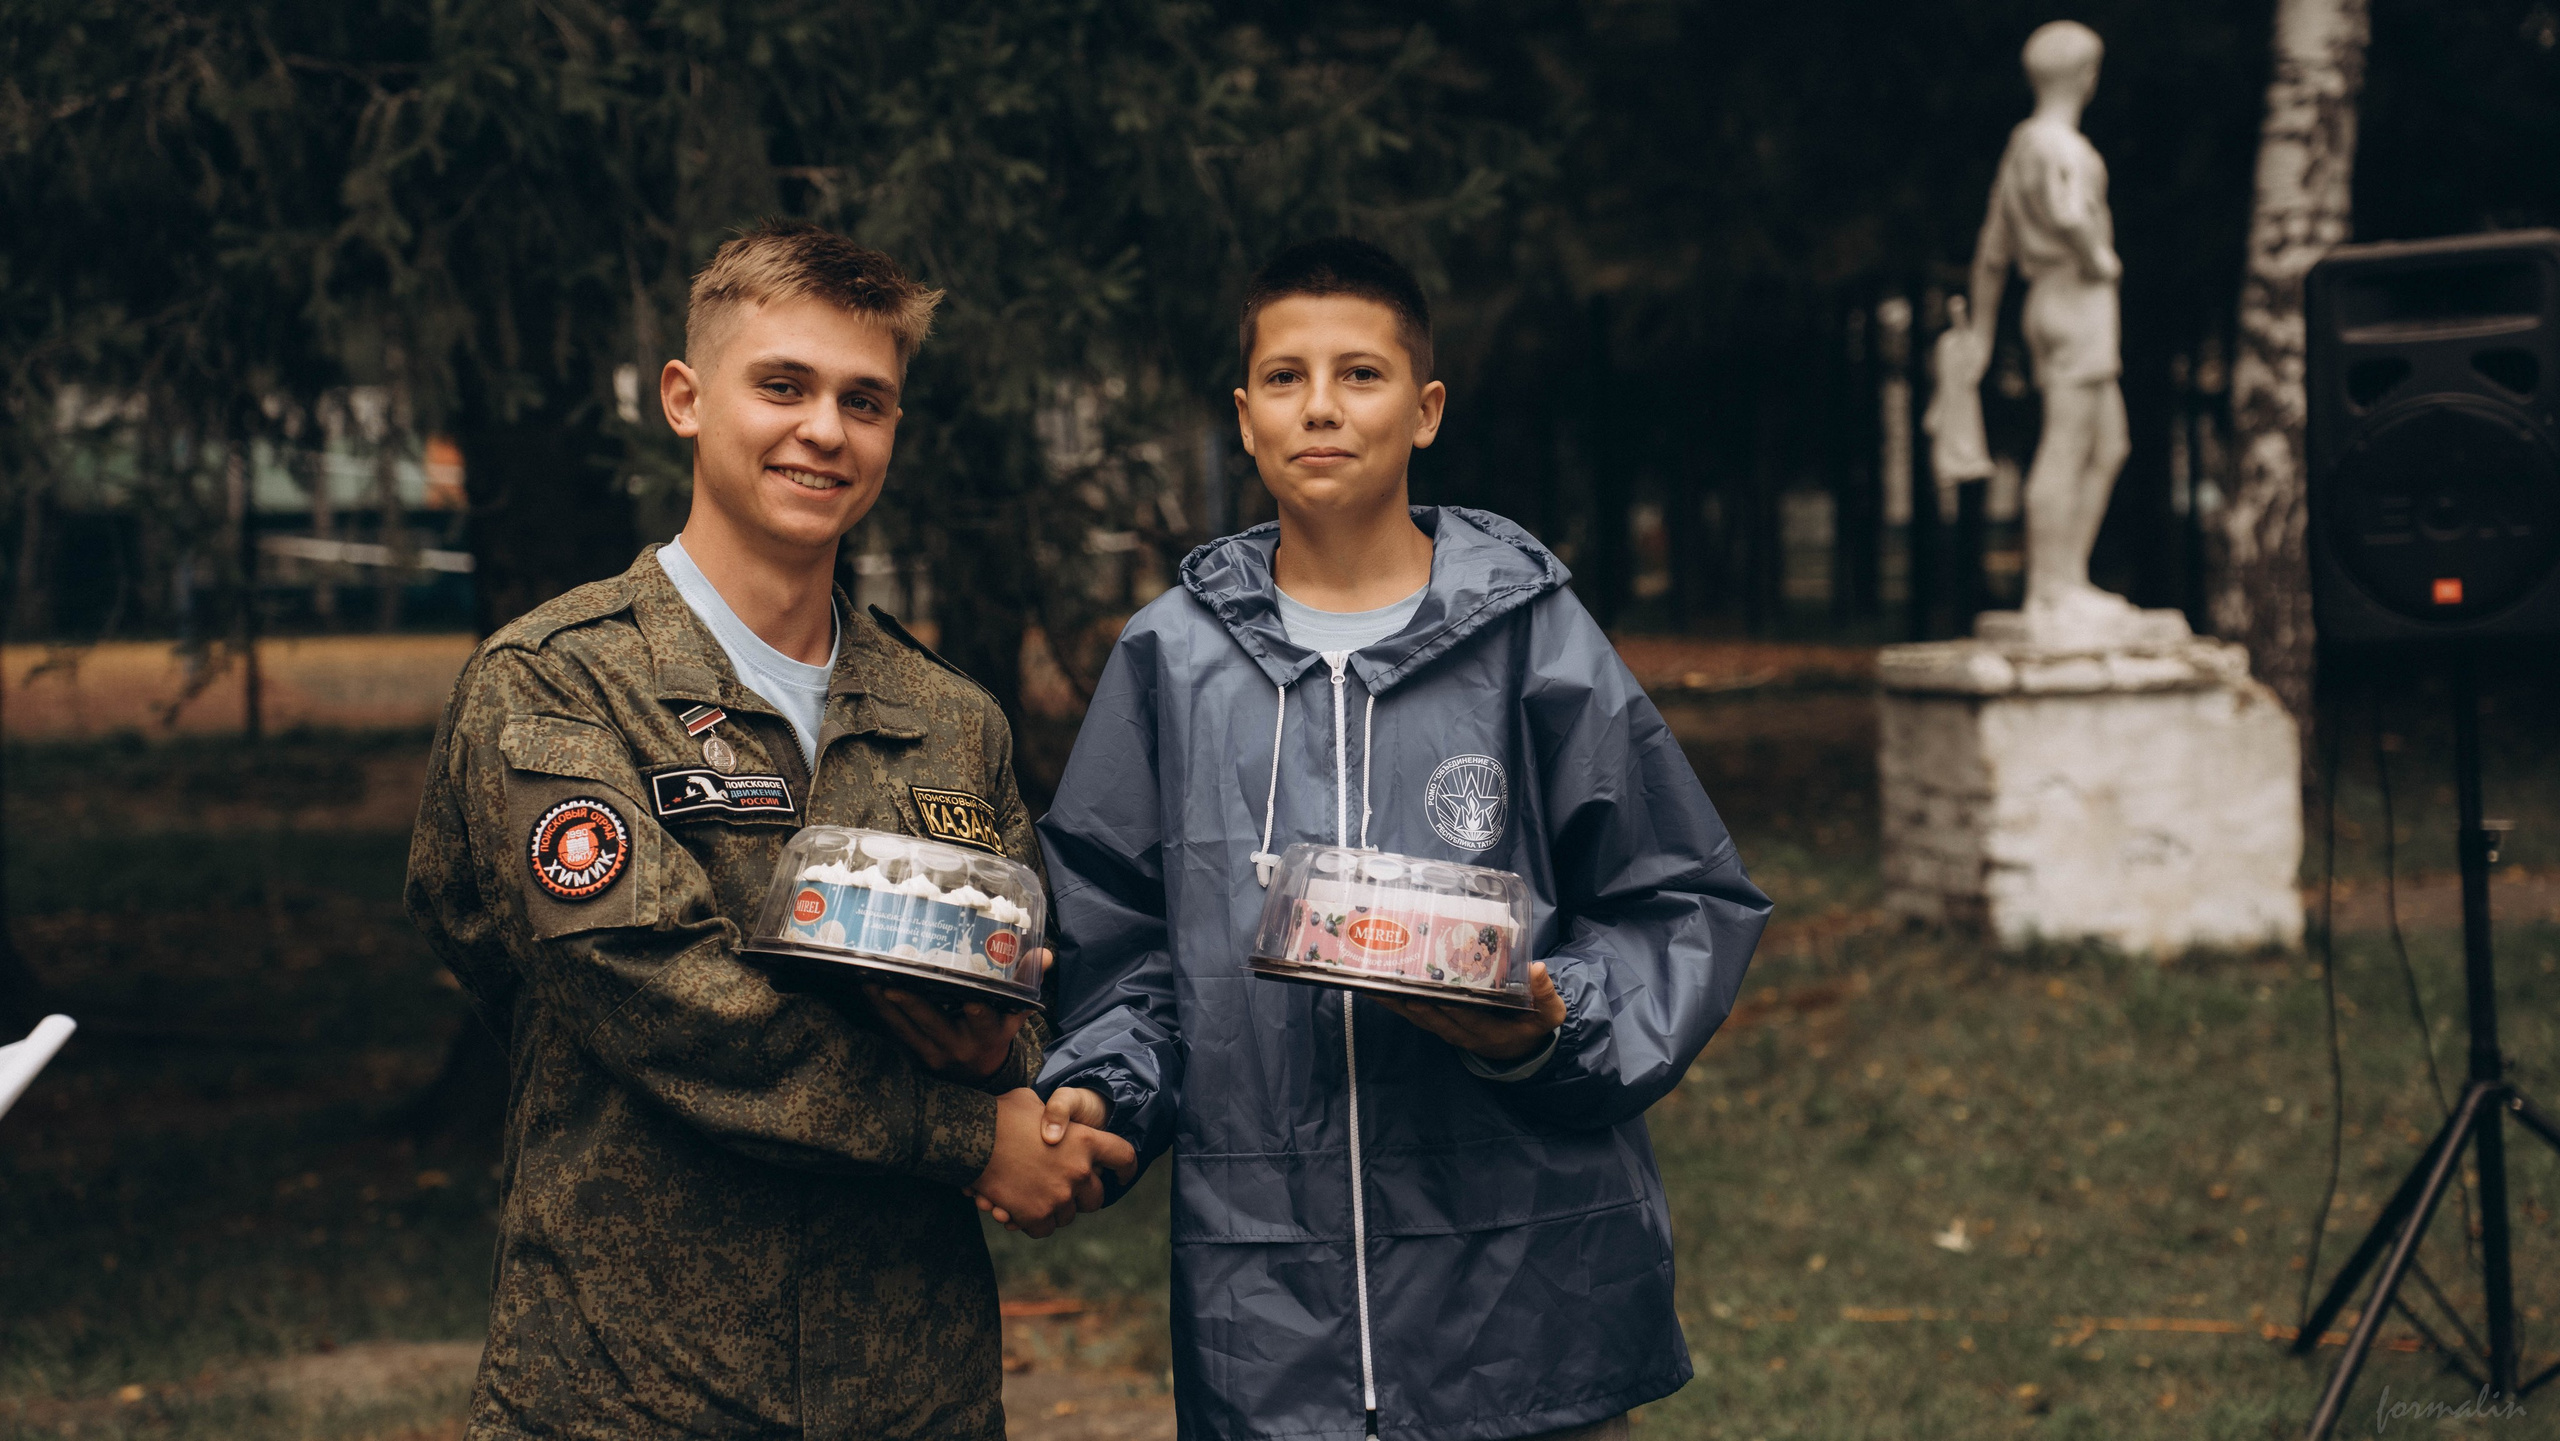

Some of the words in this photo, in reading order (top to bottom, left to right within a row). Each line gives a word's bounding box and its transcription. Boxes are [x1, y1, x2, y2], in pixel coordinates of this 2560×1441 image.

[724, 780, 783, 790] ПОИСКОВОЕ
[730, 789, 784, 799] ДВИЖЕНИЕ
[740, 798, 780, 806] РОССИИ
[917, 792, 979, 809] ПОИСКОВЫЙ
[1428, 783, 1437, 806] РОМО
[540, 807, 588, 852] ПОИСКОВЫЙ
[590, 811, 616, 841] ОТРЯД
[565, 828, 589, 840] 1990
[921, 802, 1003, 852] КАЗАНЬ
[1435, 822, 1476, 849] РЕСПУБЛИКА
[543, 848, 617, 887] ХИМИК
[795, 899, 821, 915] MIREL
[1354, 926, 1404, 944] MIREL
[989, 938, 1016, 958] MIREL
